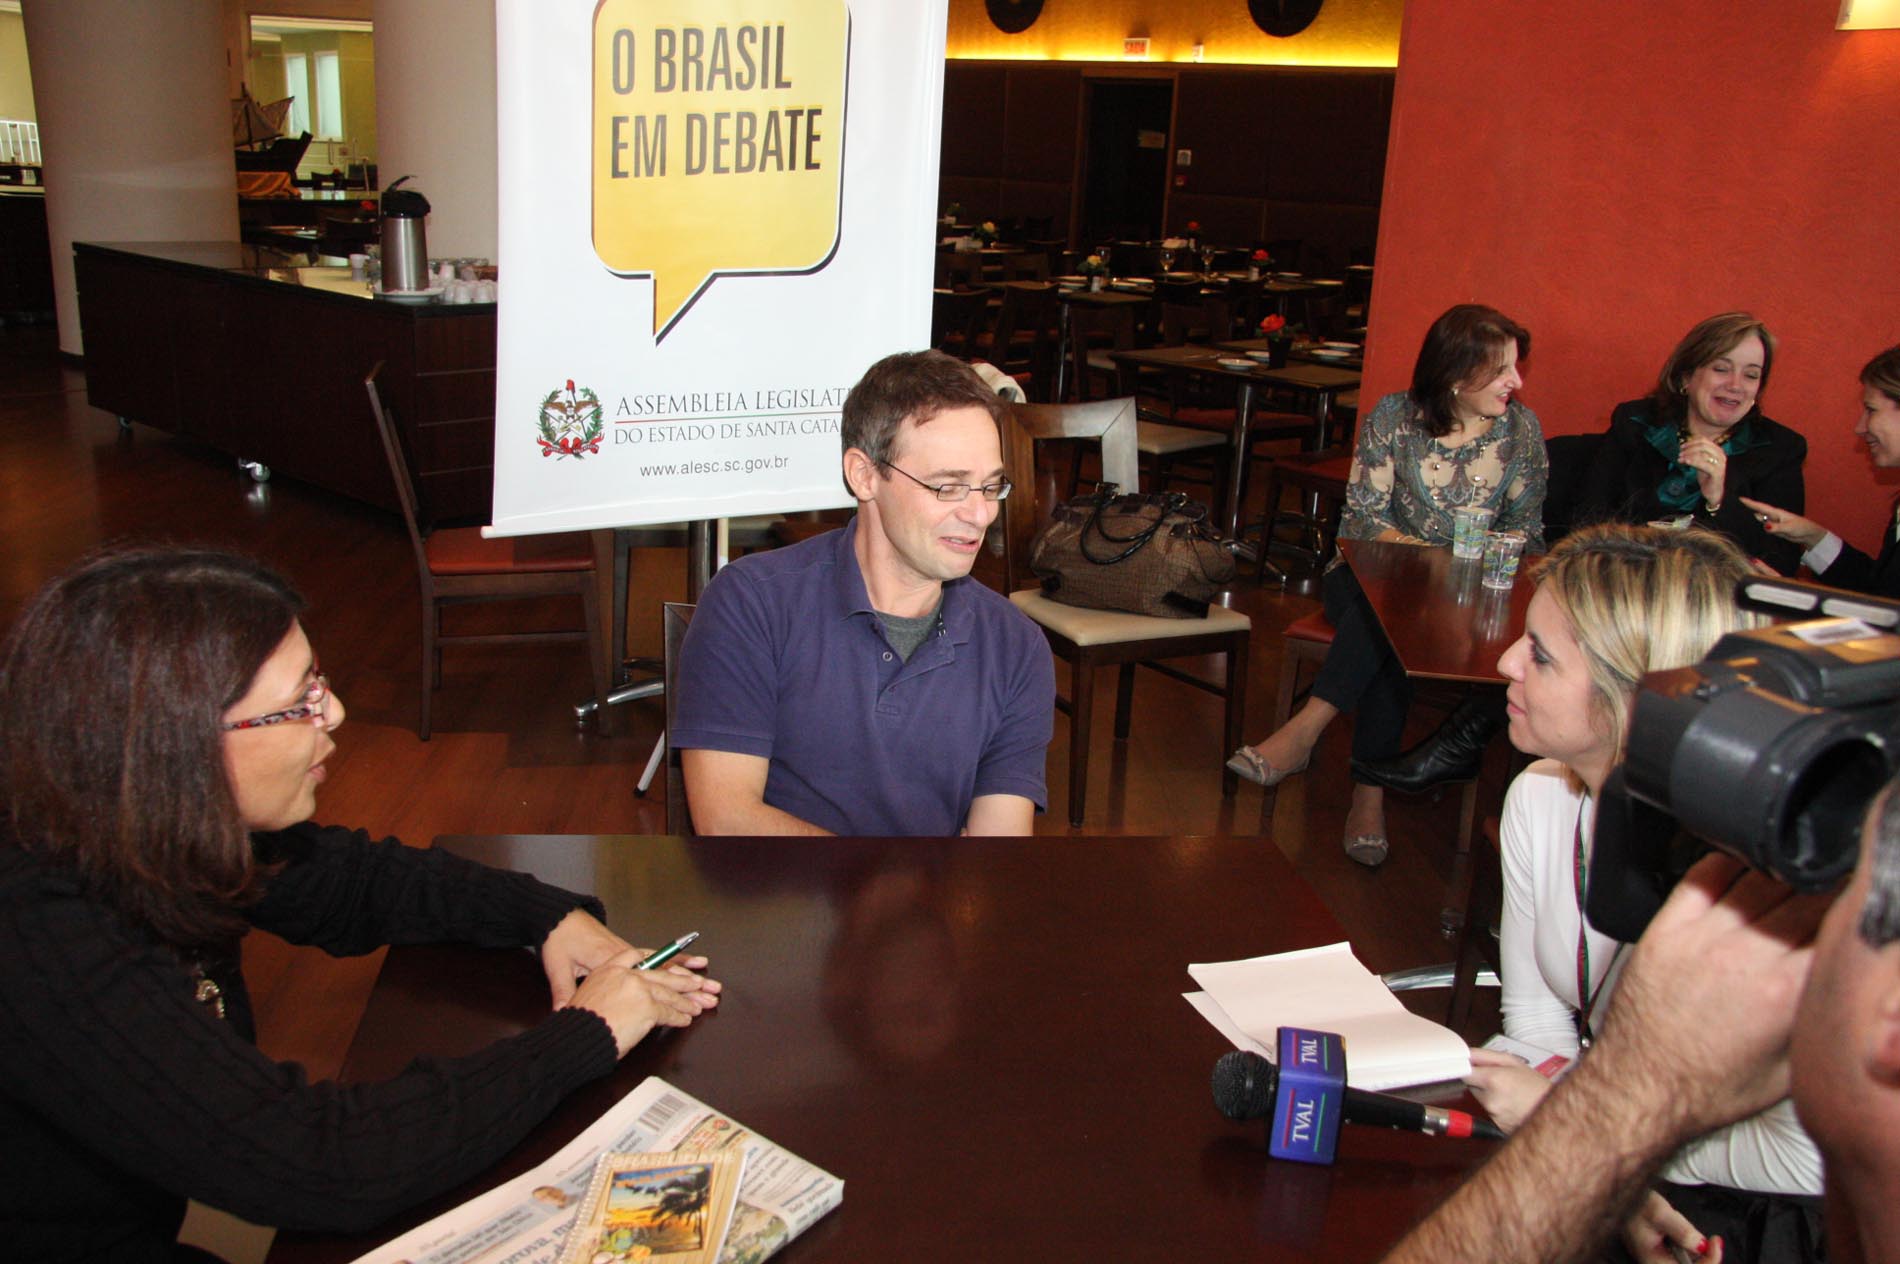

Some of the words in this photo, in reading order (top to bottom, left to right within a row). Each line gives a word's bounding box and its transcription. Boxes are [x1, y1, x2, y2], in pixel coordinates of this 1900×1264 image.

[612, 28, 636, 95] O
[654, 25, 792, 93] BRASIL
[611, 114, 667, 179] EM
[685, 108, 822, 176] DEBATE
[616, 392, 748, 416] ASSEMBLEIA
[756, 387, 850, 410] LEGISLAT
[615, 428, 643, 445] DO
[649, 424, 715, 443] ESTADO
[720, 423, 741, 439] DE
[746, 420, 797, 437] SANTA
[640, 456, 789, 477] www.alesc.sc.gov.br
[1301, 1039, 1319, 1064] TVAL
[1292, 1100, 1314, 1142] TVAL
